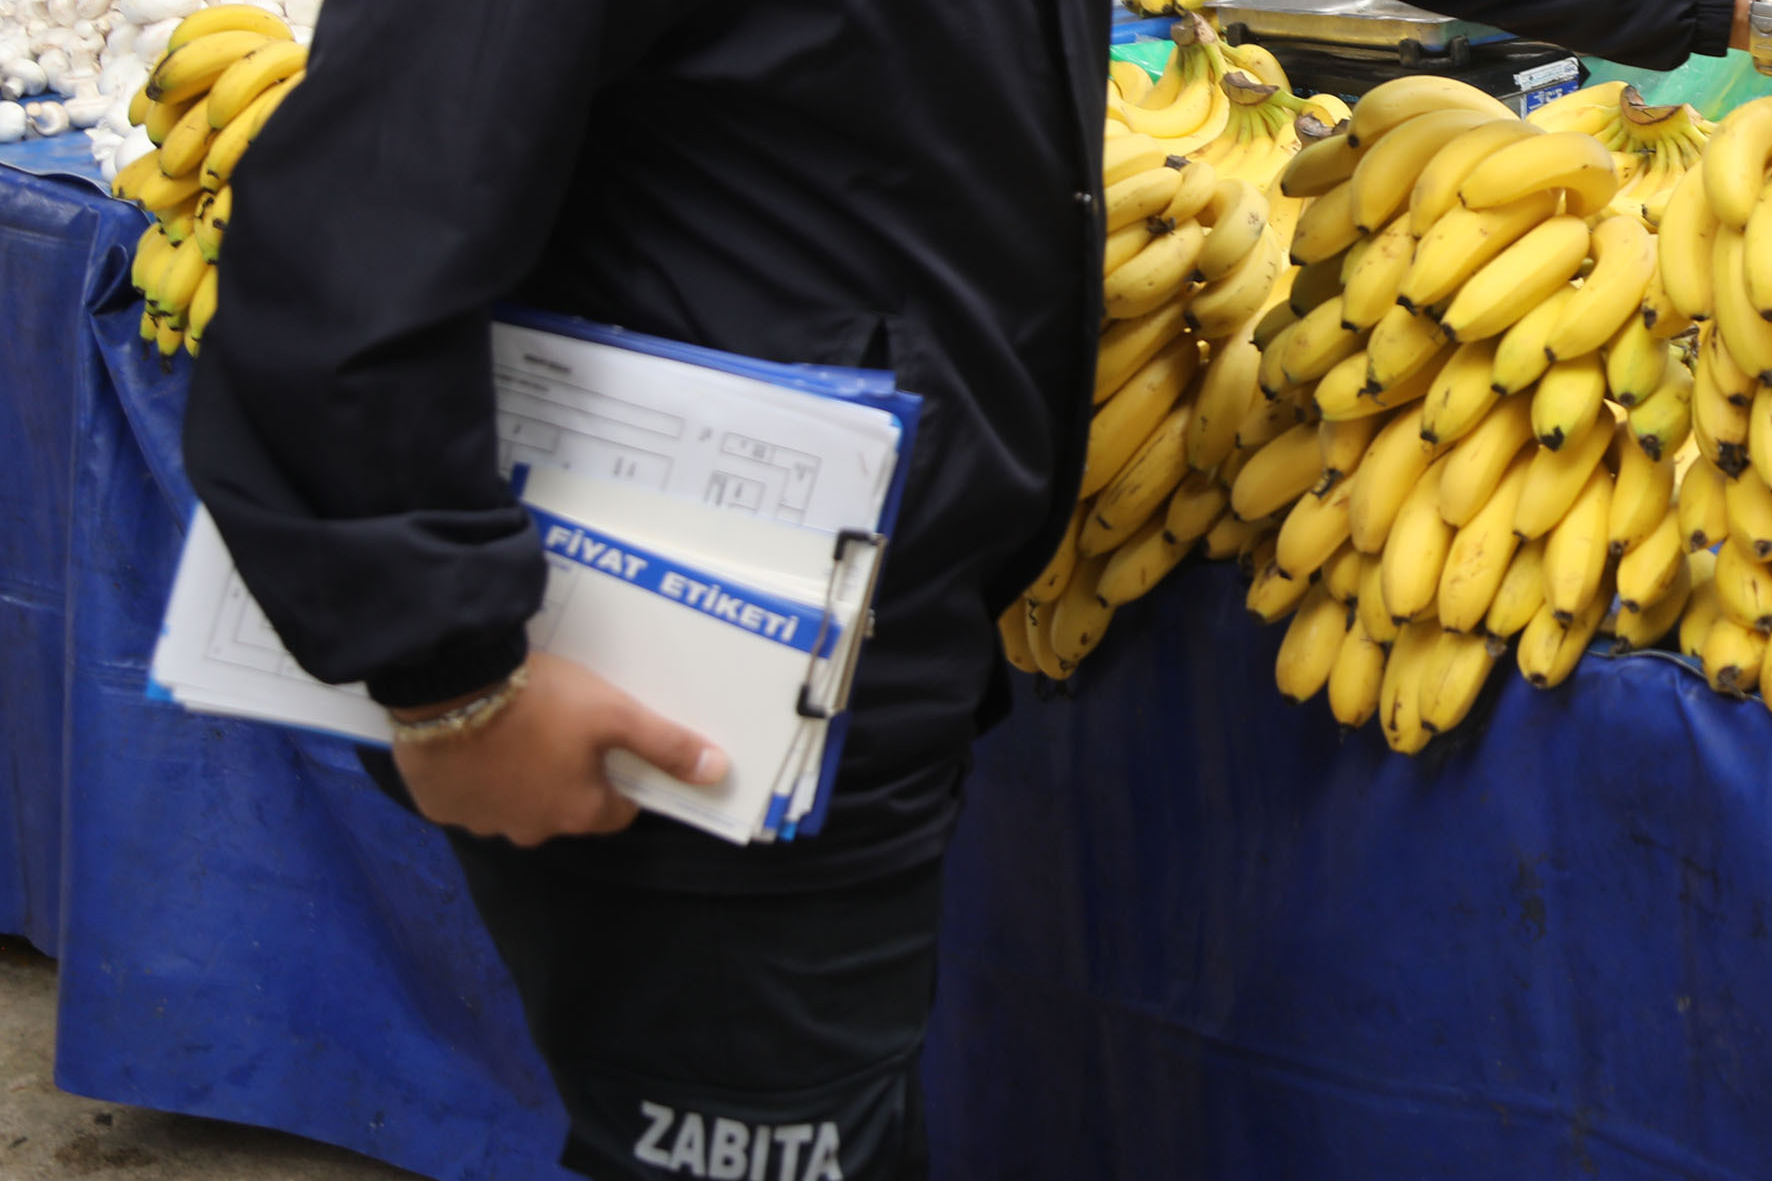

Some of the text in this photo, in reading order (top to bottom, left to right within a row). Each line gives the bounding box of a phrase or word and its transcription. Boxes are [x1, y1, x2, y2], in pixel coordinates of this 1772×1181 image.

[545, 523, 799, 644] FİYAT ETİKETİ
[633, 1098, 844, 1181] ZABITA
